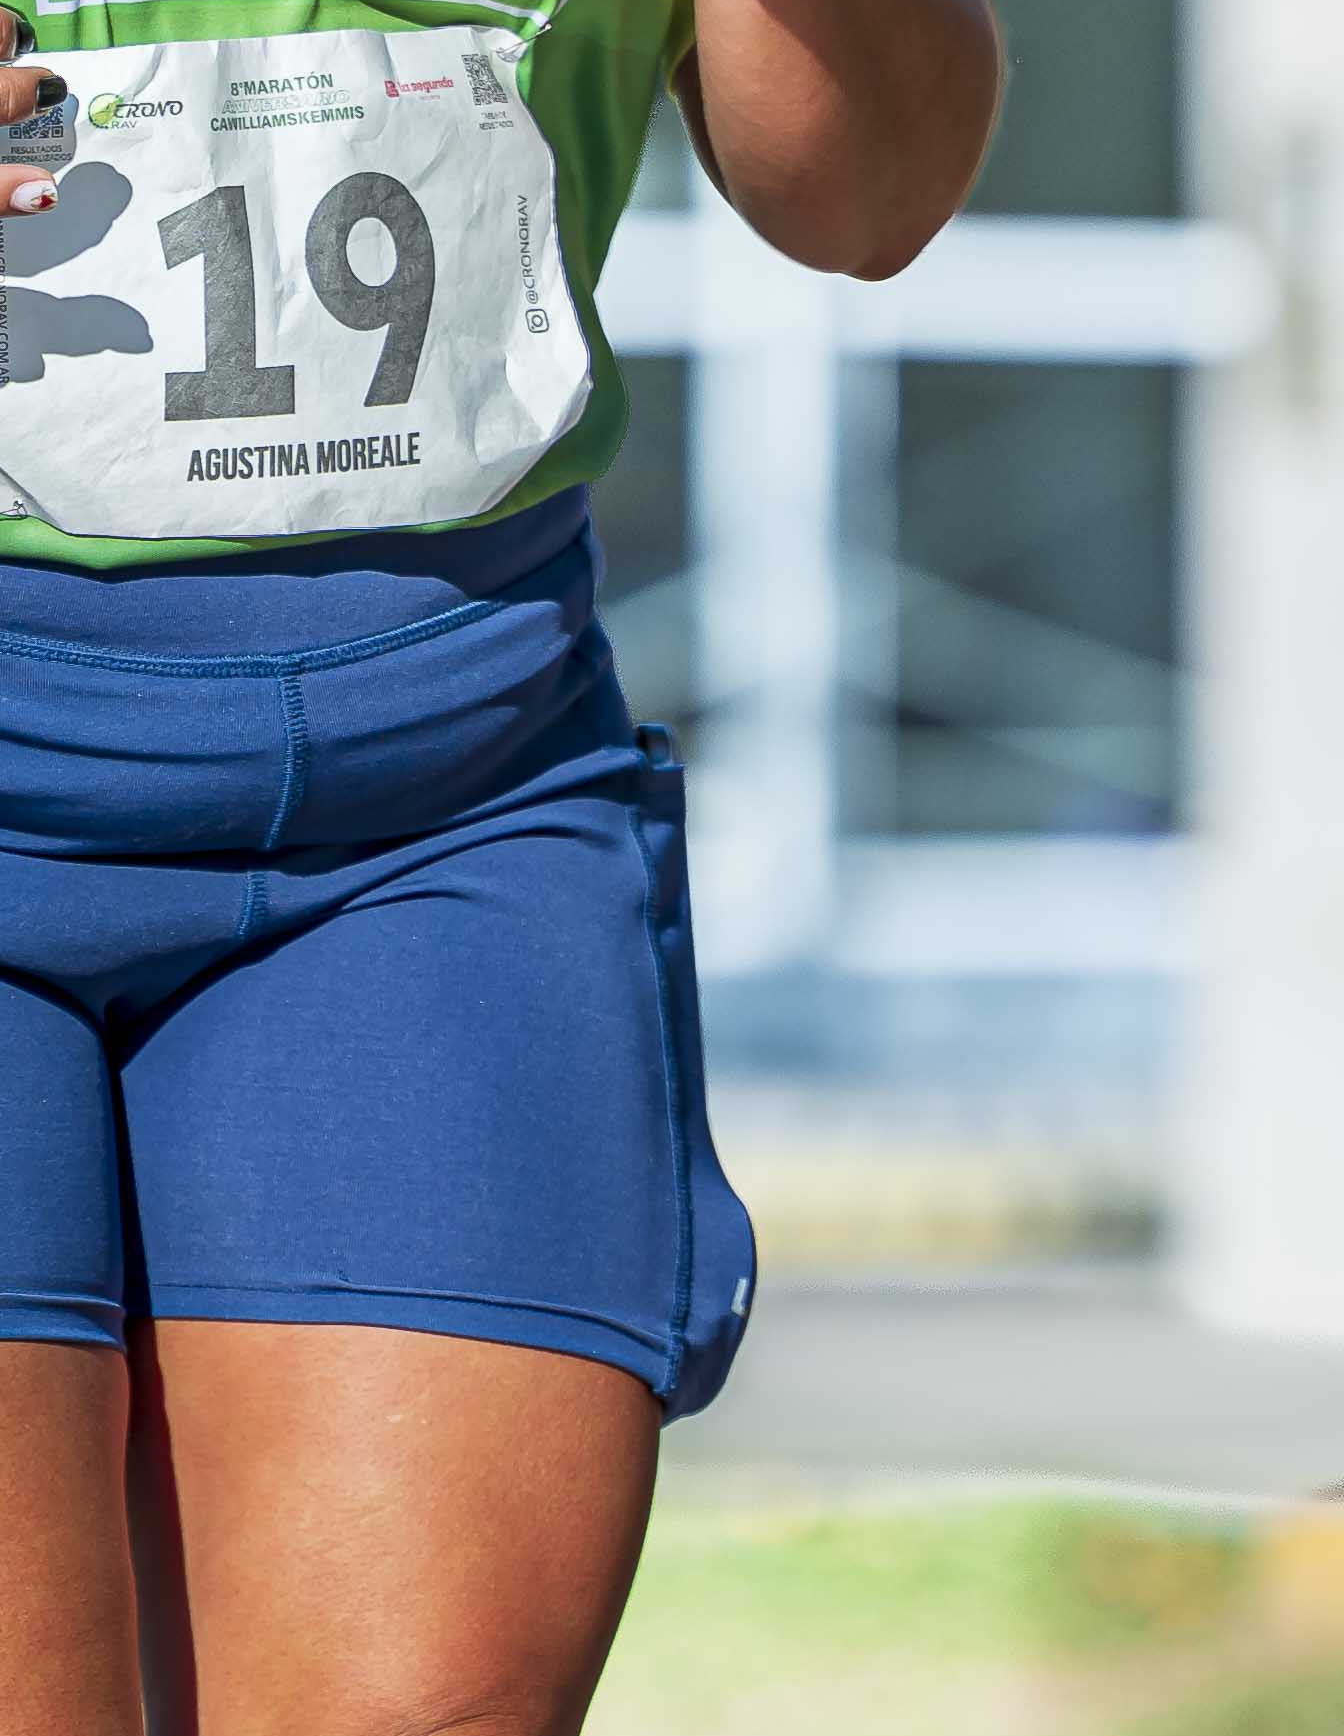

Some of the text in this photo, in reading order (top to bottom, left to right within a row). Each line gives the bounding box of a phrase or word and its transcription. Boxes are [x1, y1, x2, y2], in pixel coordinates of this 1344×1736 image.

[112, 120, 138, 129] RAV
[113, 101, 183, 118] CRONO
[210, 106, 365, 131] CAWILLIAMSKEMMIS
[517, 194, 539, 304] @CRONORAV
[157, 172, 435, 421] 19
[187, 432, 421, 482] AGUSTINA MOREALE
